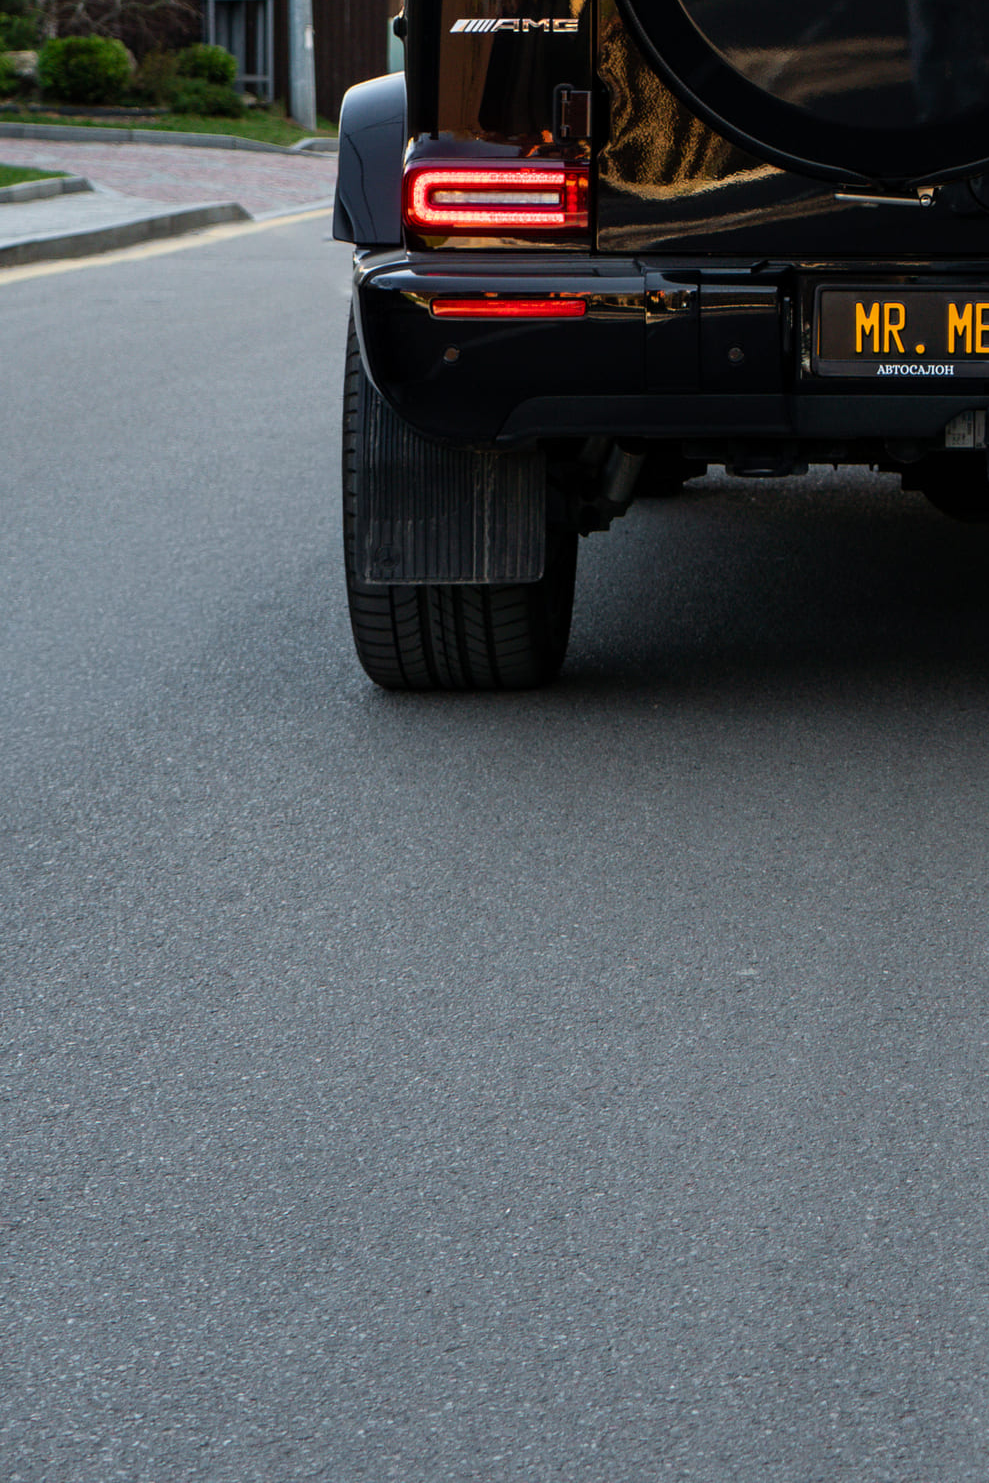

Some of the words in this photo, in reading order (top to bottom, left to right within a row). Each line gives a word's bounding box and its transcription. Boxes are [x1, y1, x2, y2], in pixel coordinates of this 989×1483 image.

[490, 18, 579, 33] AMG
[855, 302, 925, 354] MR.
[876, 364, 955, 376] АВТОСАЛОН
